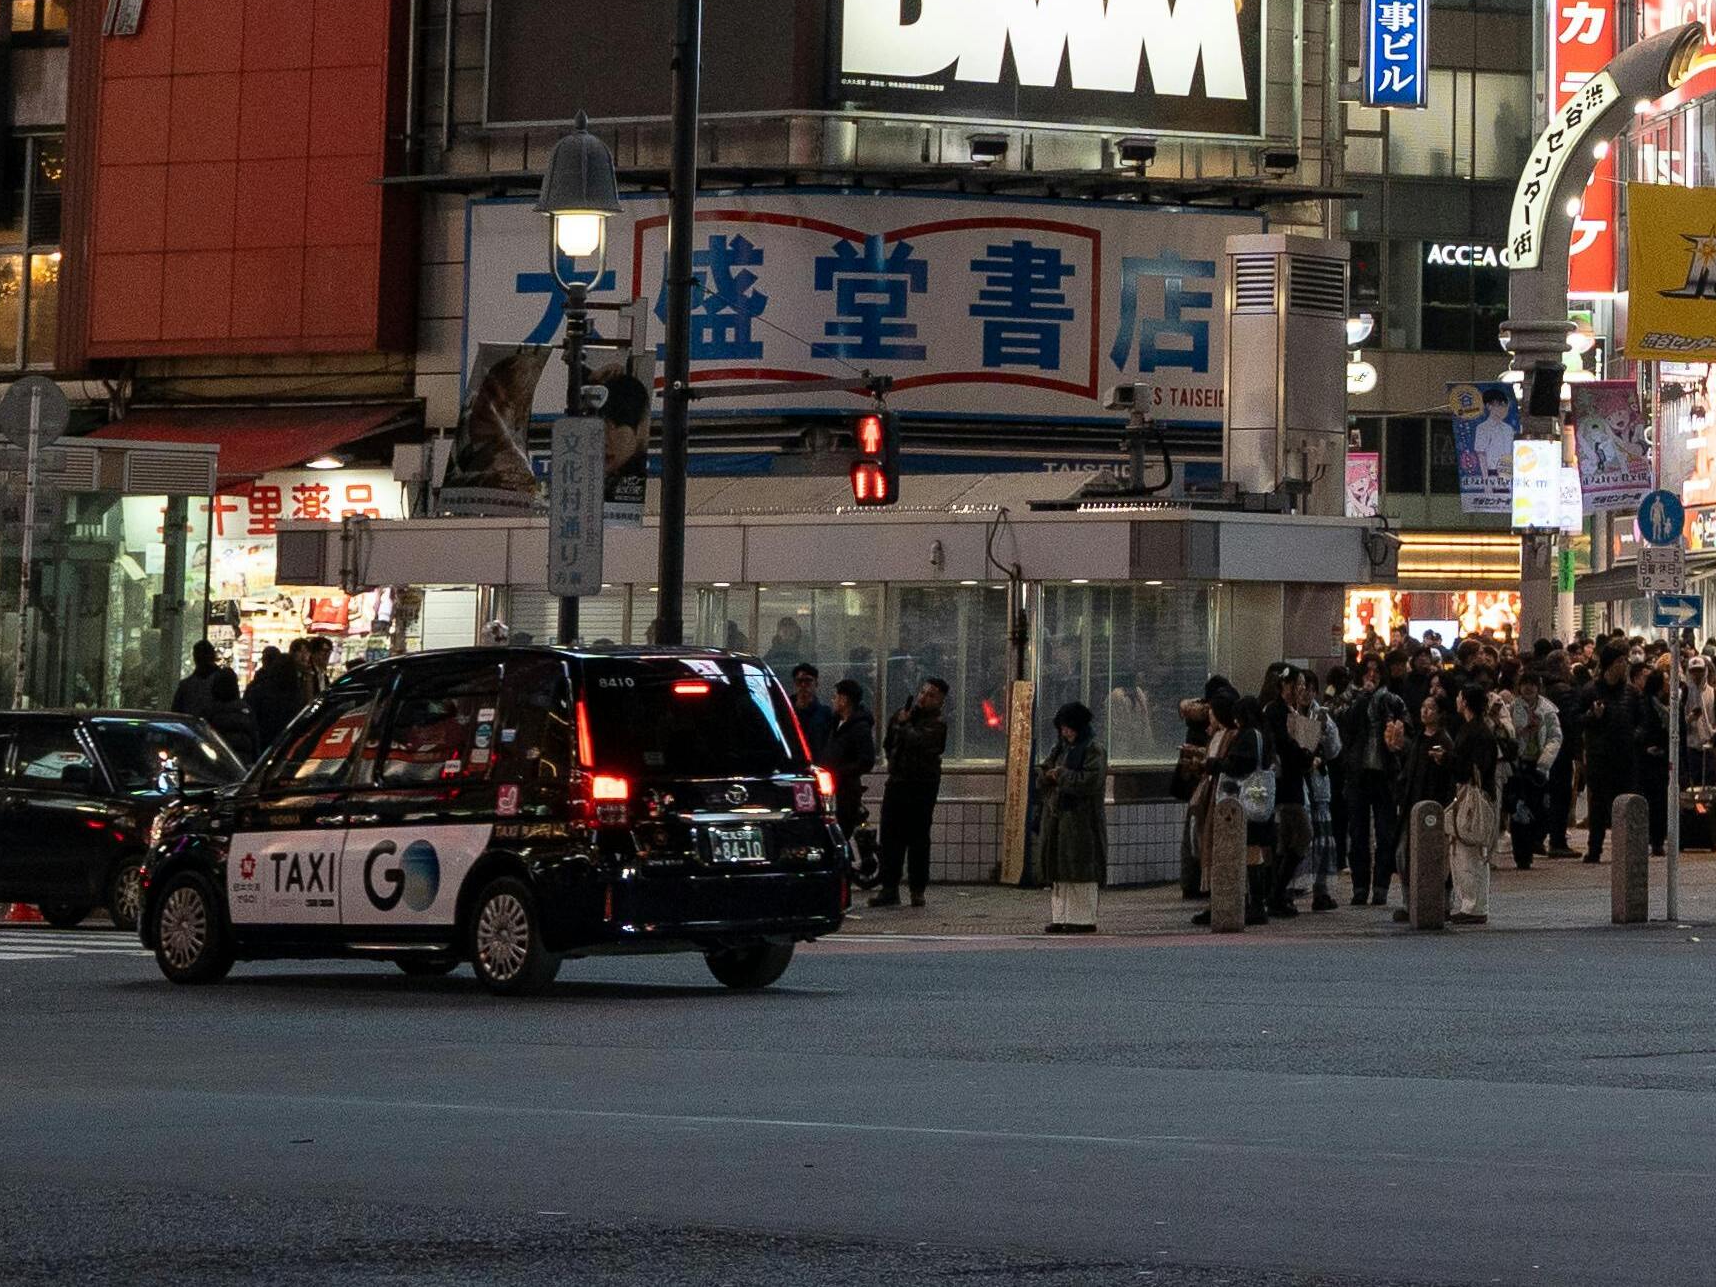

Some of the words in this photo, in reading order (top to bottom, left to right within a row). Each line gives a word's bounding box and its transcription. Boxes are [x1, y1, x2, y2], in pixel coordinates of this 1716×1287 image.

[1514, 82, 1604, 262] 渋谷センター街
[515, 232, 1217, 374] 大盛堂書店
[270, 848, 335, 893] TAXI
